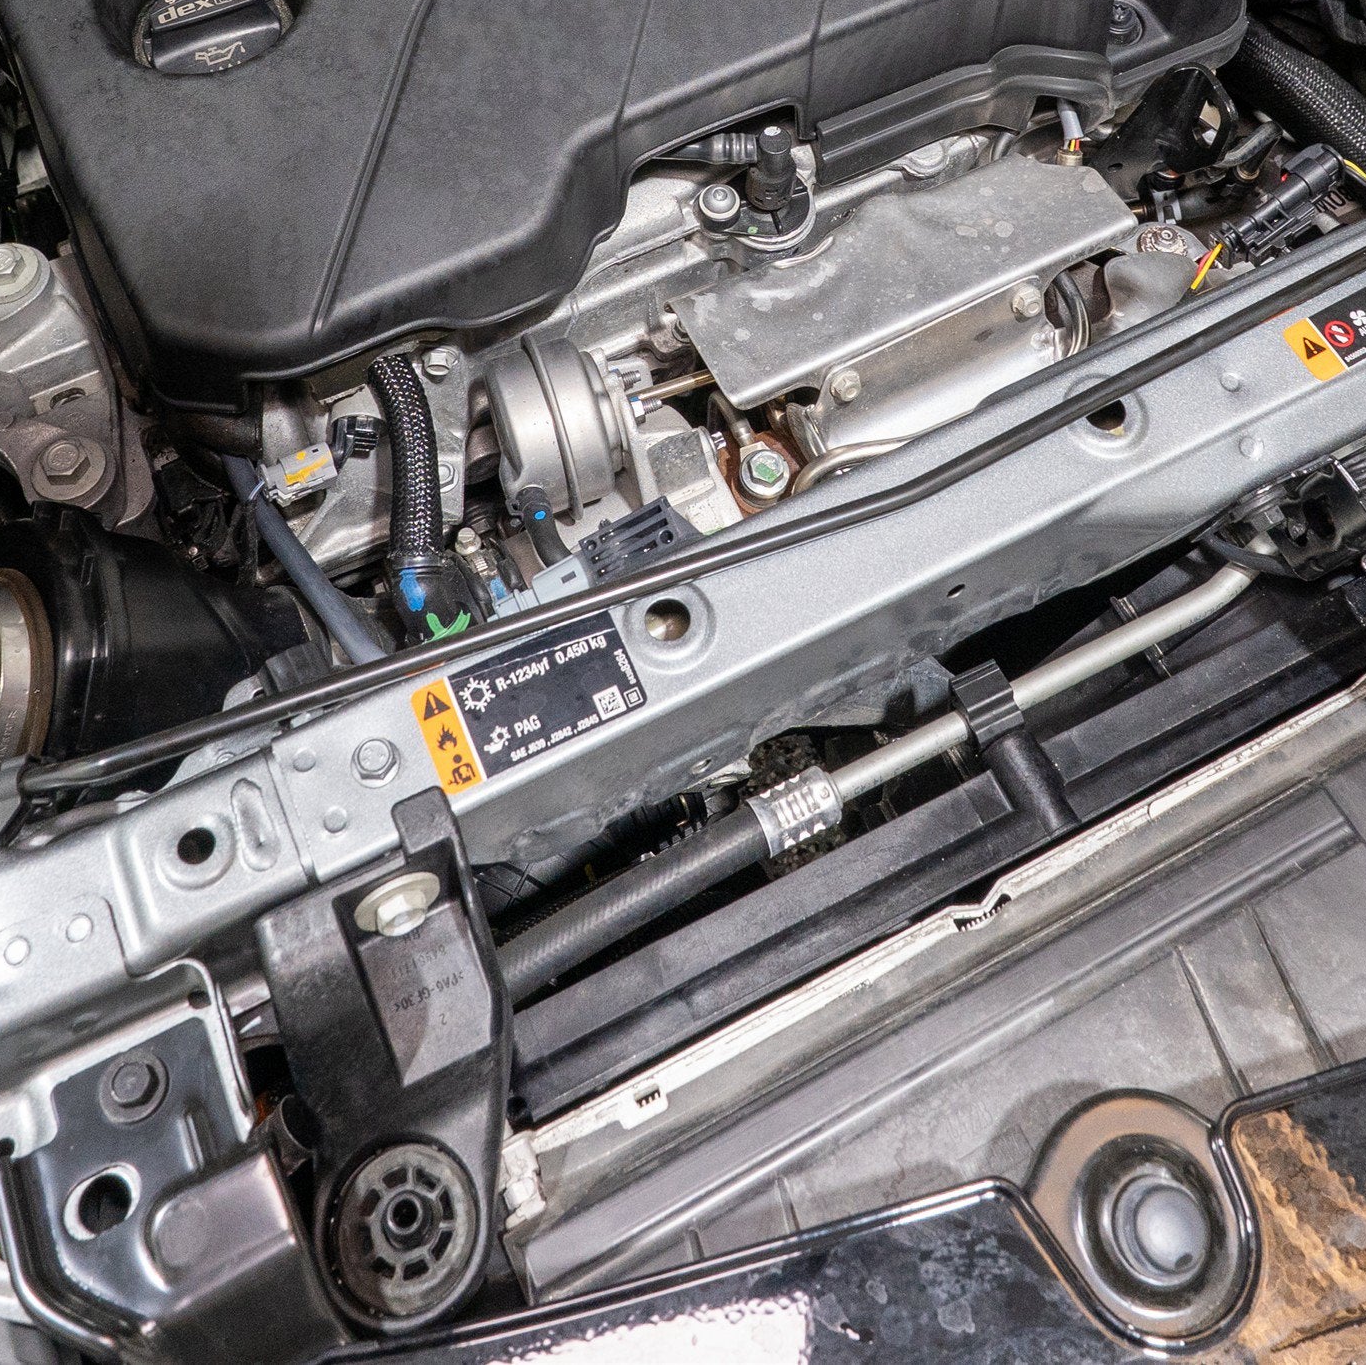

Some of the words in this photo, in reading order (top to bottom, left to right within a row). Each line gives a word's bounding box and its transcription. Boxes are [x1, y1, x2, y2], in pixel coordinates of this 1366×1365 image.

[495, 657, 551, 692] R-1234yf
[555, 641, 589, 665] 0.450
[590, 635, 607, 652] kg
[513, 715, 542, 737] PAG
[511, 748, 527, 762] SAE
